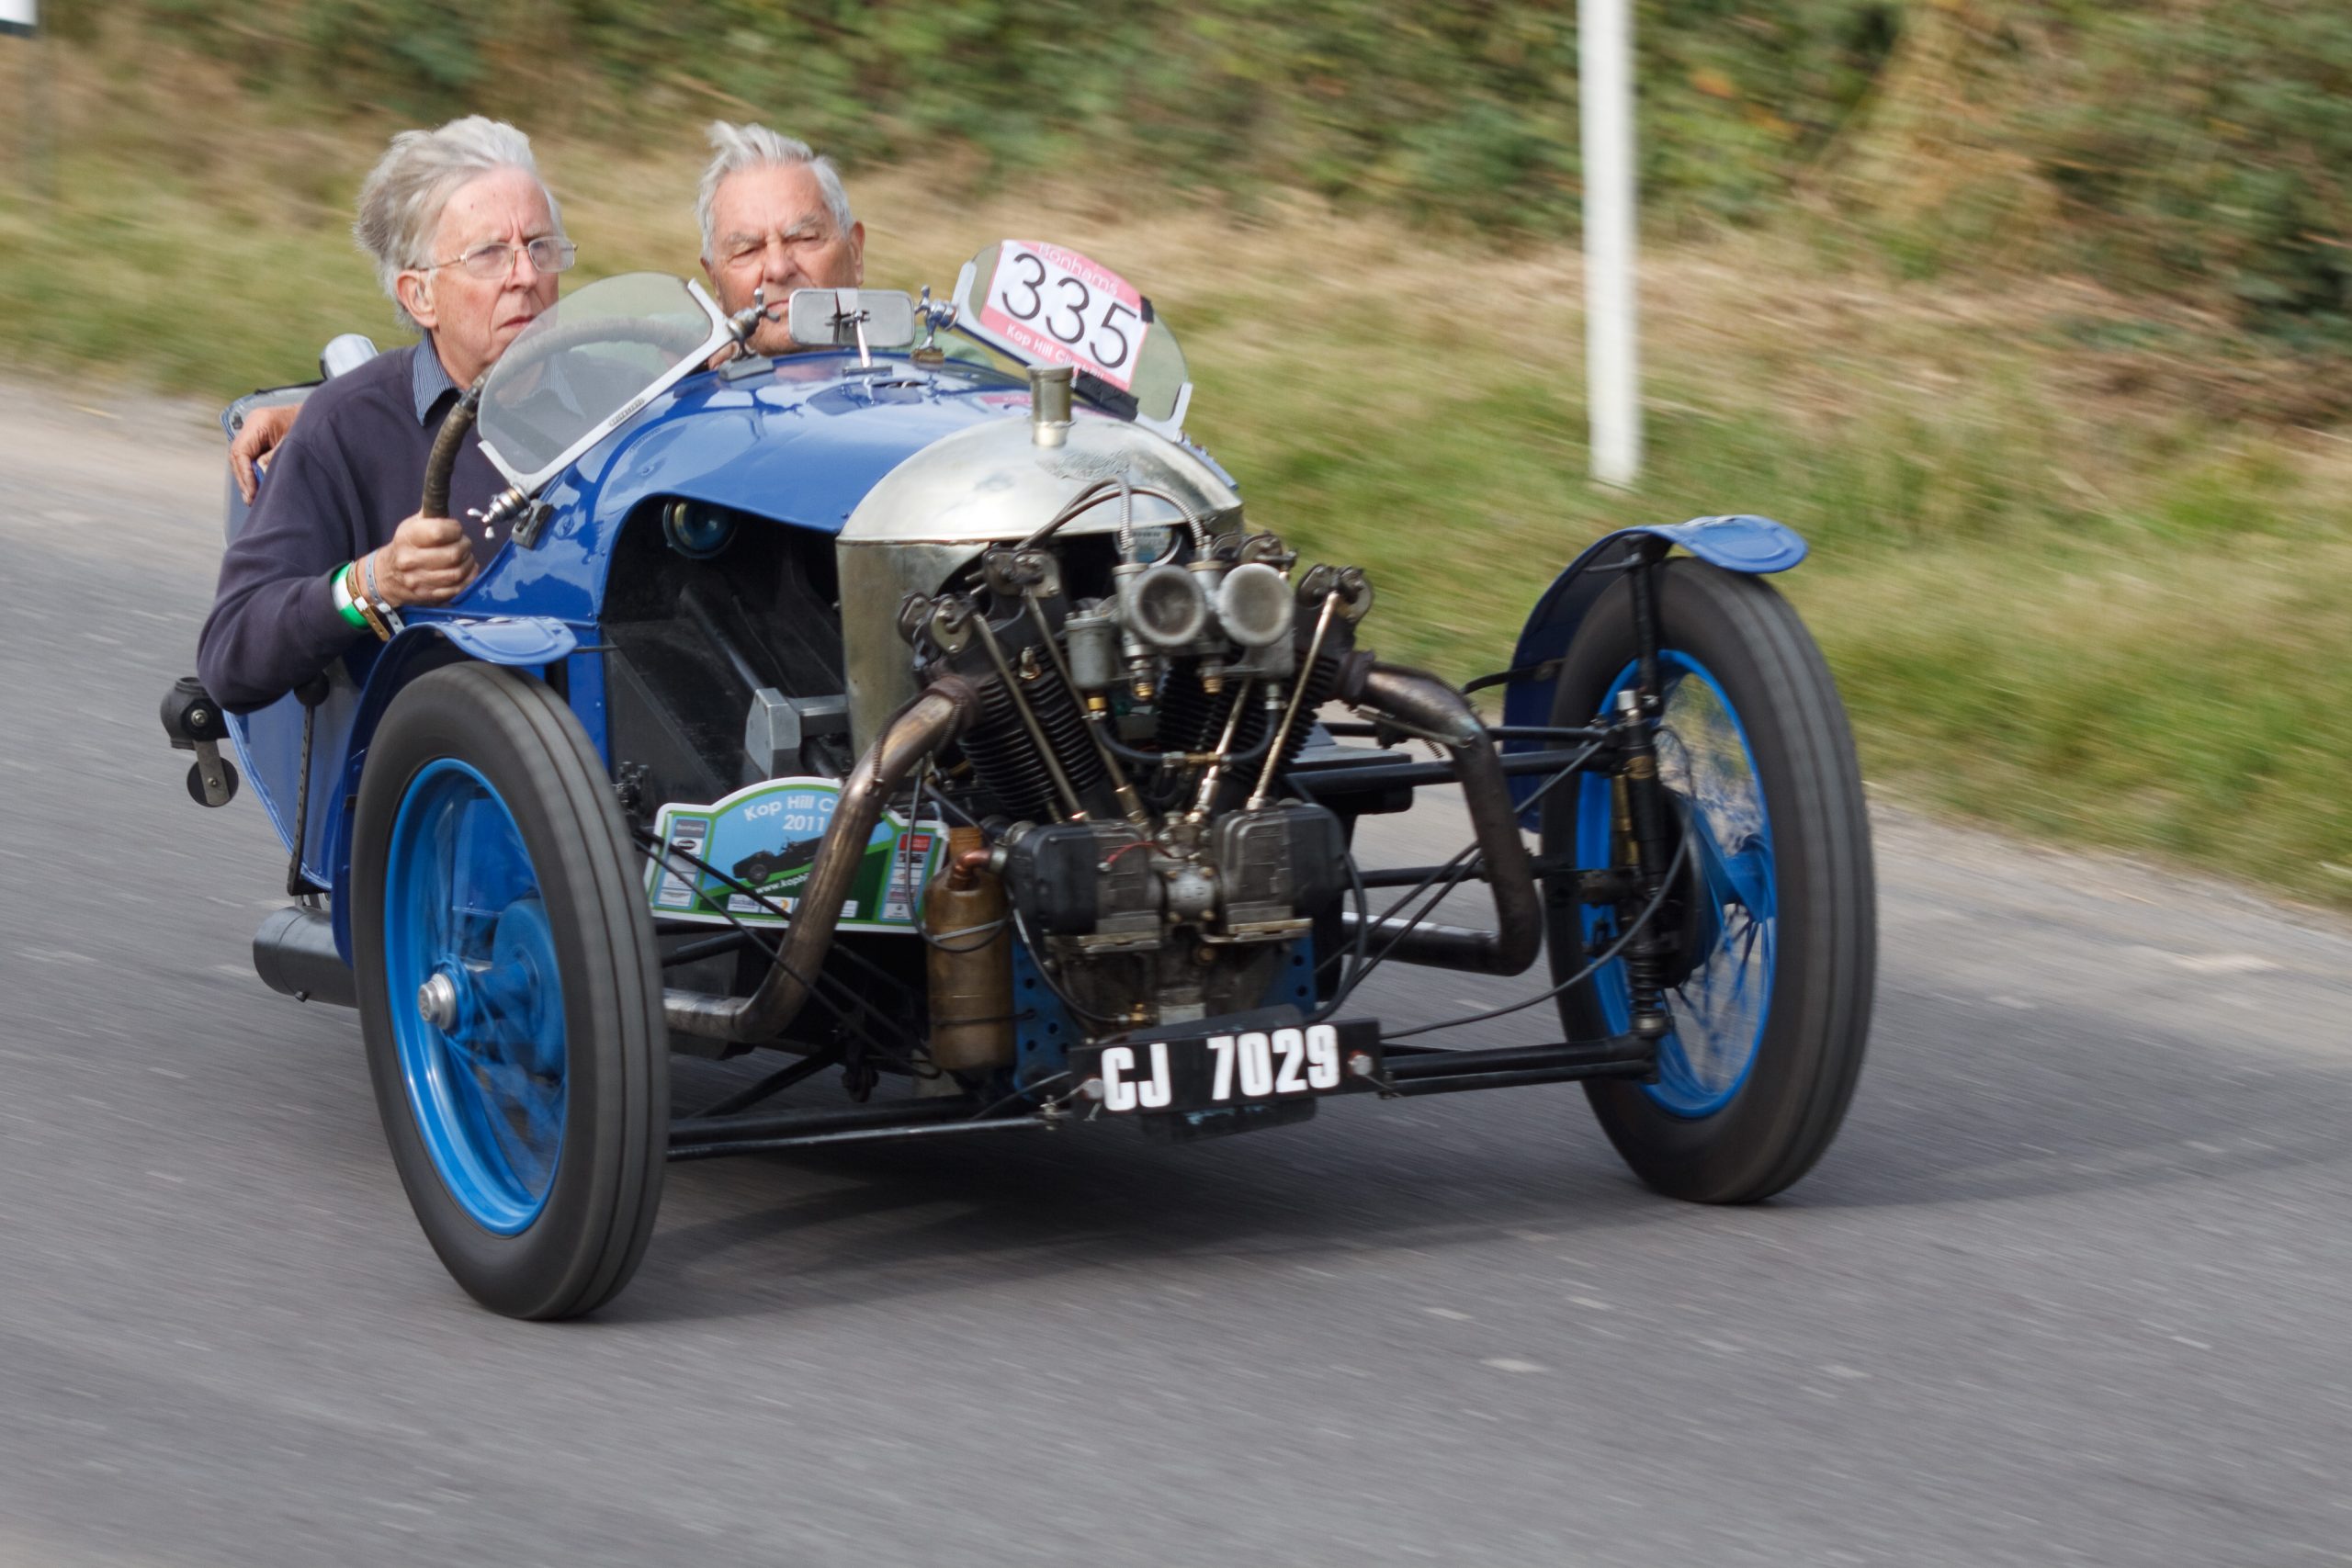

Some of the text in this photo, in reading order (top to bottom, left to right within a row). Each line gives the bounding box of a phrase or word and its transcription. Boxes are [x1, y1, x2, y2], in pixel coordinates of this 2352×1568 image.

[1001, 253, 1137, 368] 335
[1006, 322, 1032, 347] Kop
[1033, 338, 1054, 359] Hill
[742, 800, 783, 822] Kop
[786, 795, 816, 810] Hill
[782, 814, 826, 831] 2011
[1101, 1023, 1340, 1111] CJ 7029
